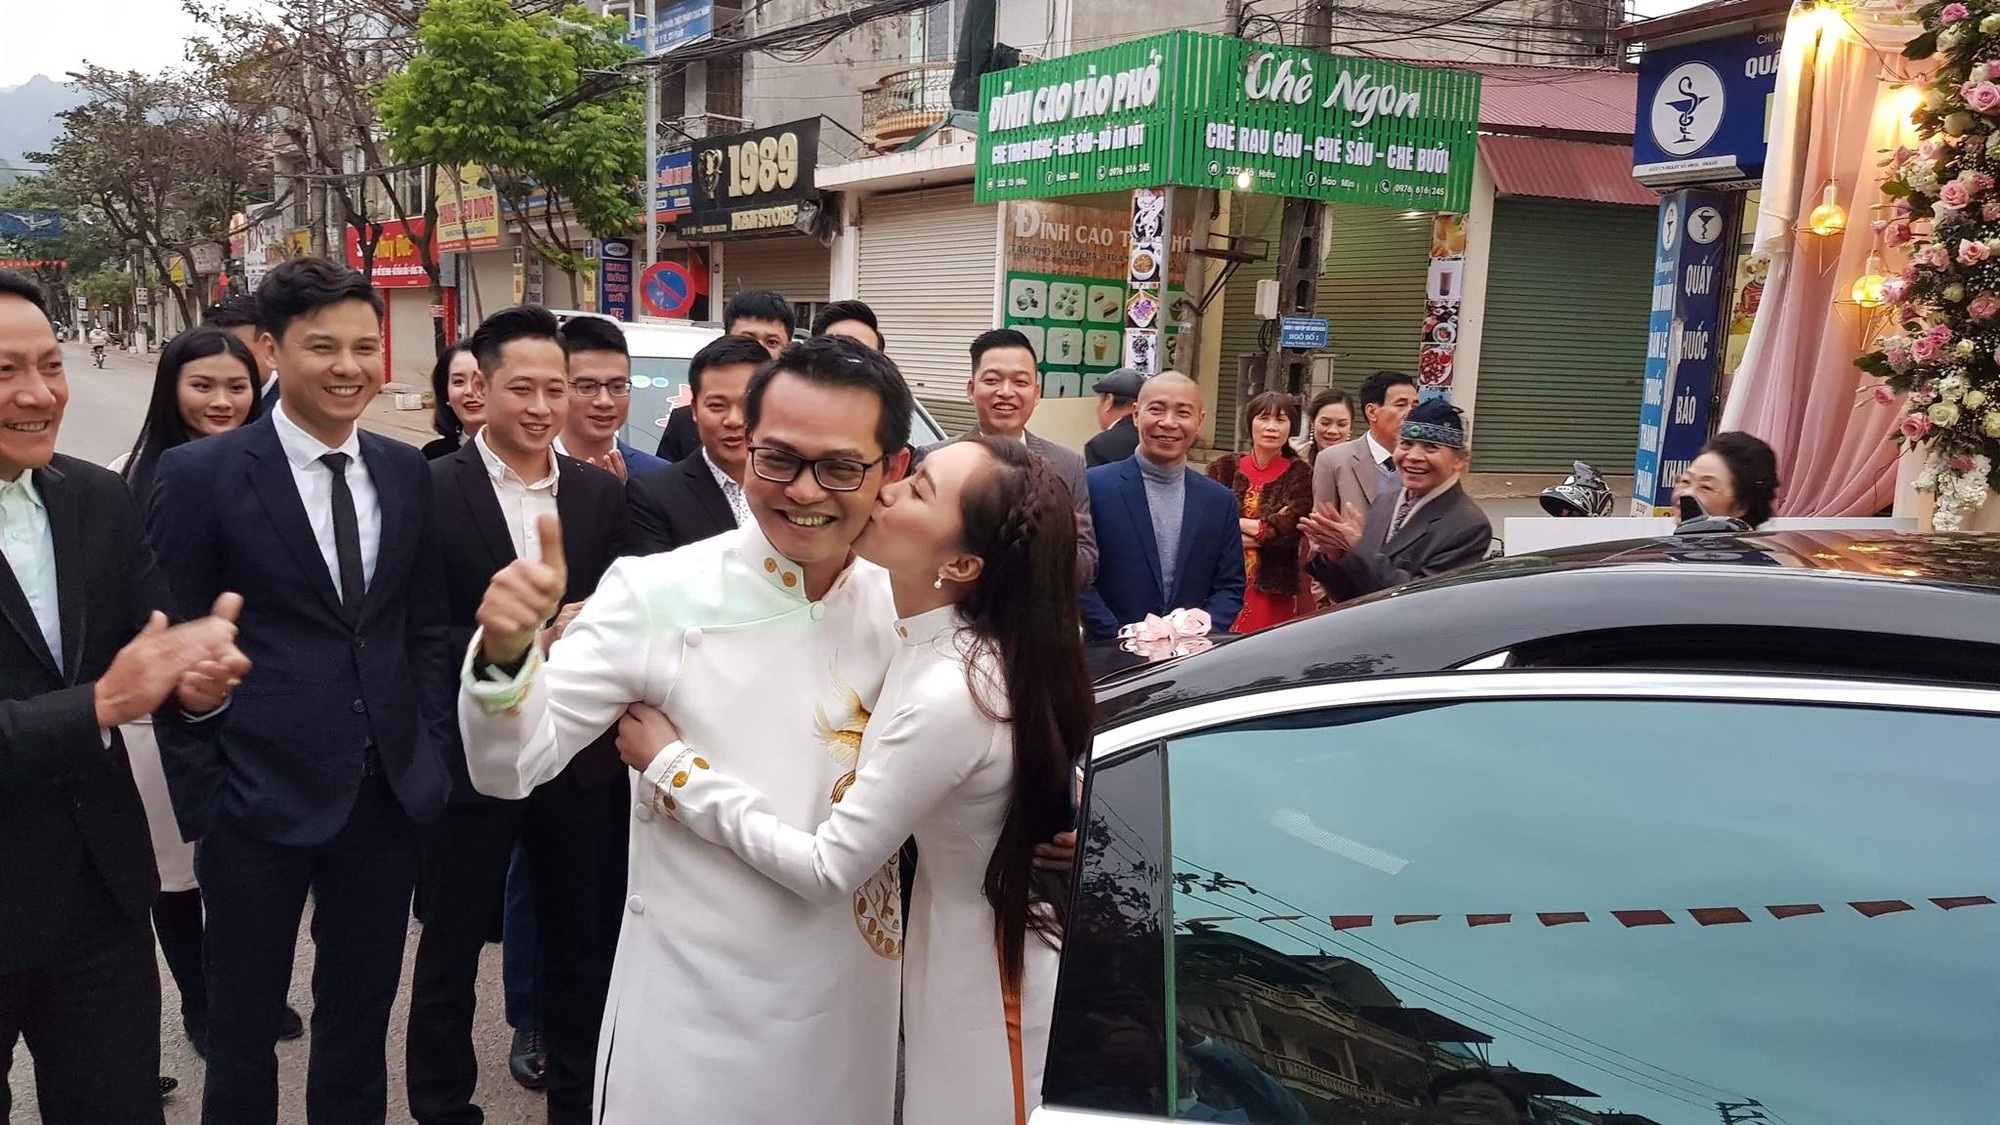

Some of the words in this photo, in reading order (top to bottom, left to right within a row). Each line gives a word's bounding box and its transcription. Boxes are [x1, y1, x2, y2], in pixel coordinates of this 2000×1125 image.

[988, 81, 1034, 132] ĐỈNH
[1033, 83, 1072, 125] CAO
[1072, 65, 1113, 118] TÀO
[1245, 52, 1313, 104] Chè
[1322, 70, 1420, 128] Ngon
[728, 132, 798, 197] 1989
[992, 141, 1007, 165] CHÈ
[1058, 130, 1075, 156] CHÈ
[1206, 120, 1235, 151] CHÈ
[1239, 126, 1270, 155] RAU
[1273, 127, 1303, 158] CÂU
[1315, 134, 1343, 163] CHÈ
[1387, 141, 1414, 170] CHÈ
[1417, 141, 1450, 174] BƯỞI
[1109, 167, 1124, 177] 0976
[1125, 164, 1137, 174] 616
[1138, 163, 1151, 172] 245
[1226, 166, 1240, 175] 332
[1395, 184, 1412, 193] 0976
[1415, 185, 1428, 194] 616
[1431, 186, 1445, 196] 245
[1015, 204, 1070, 242] ĐỈNH
[1681, 321, 1709, 360] HUỐC
[1675, 386, 1697, 425] BẢO
